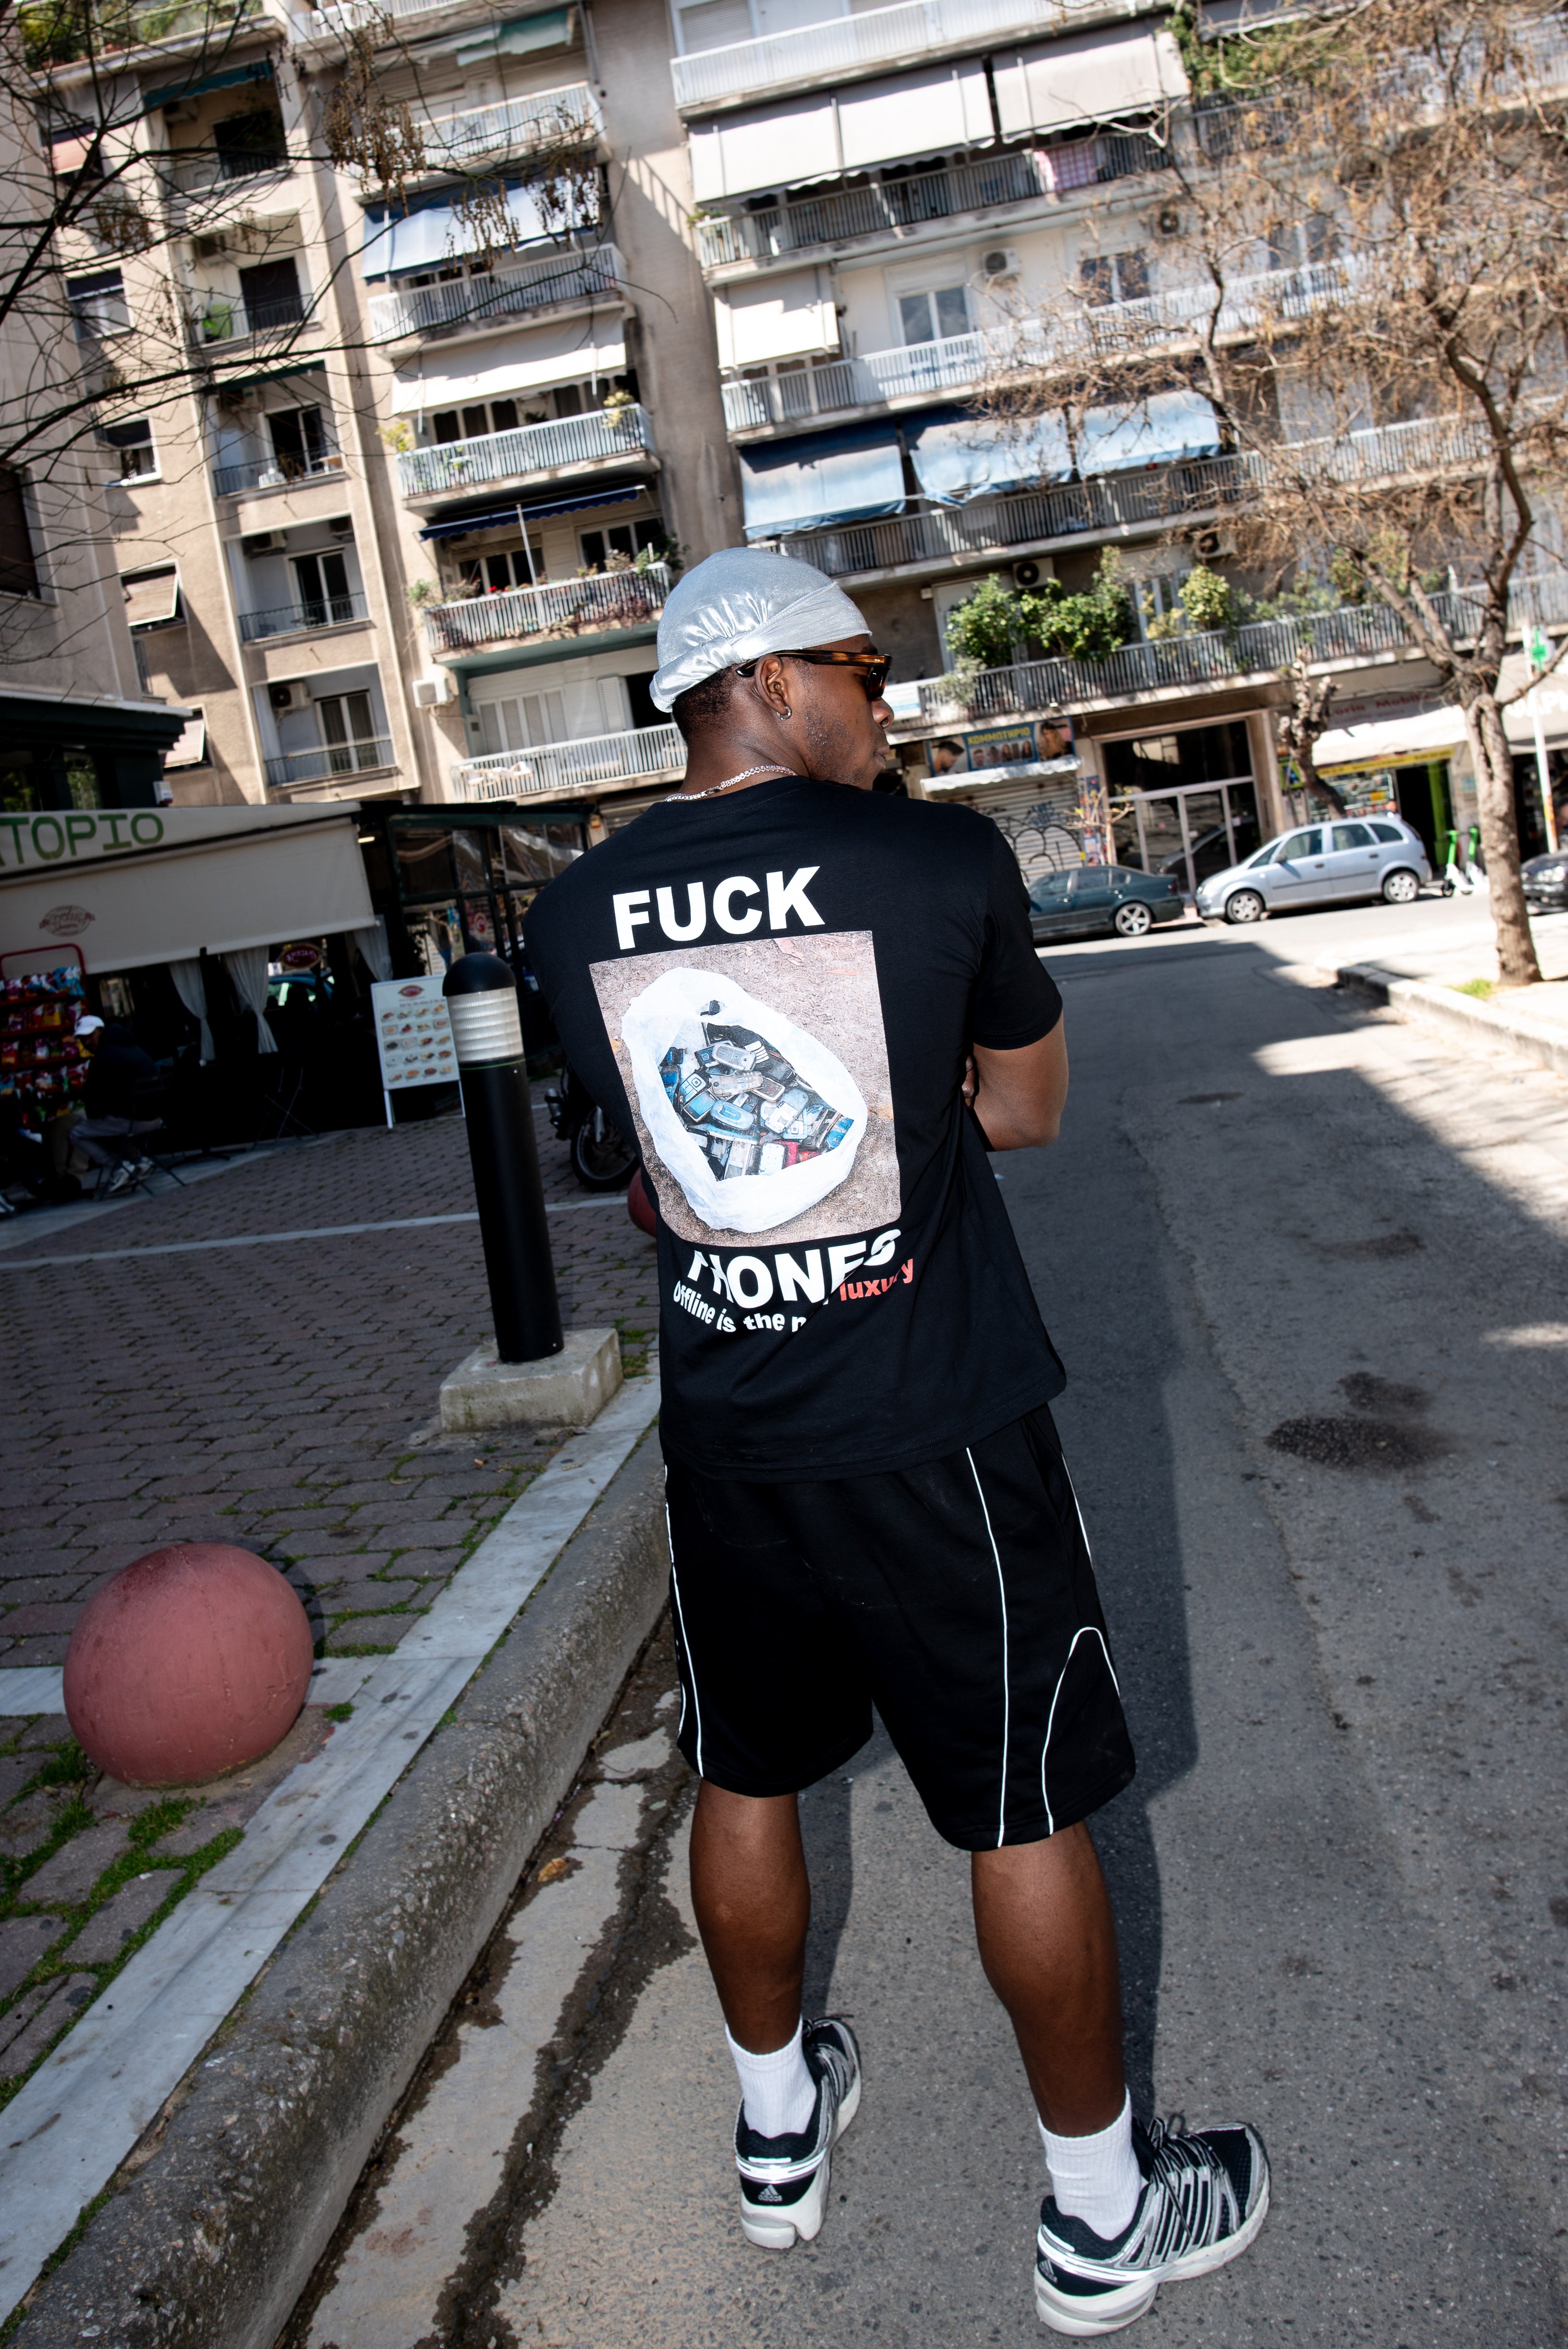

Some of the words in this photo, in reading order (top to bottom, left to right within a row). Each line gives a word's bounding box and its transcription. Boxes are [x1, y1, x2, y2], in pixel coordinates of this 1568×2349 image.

[0, 813, 164, 865] ΤΟΡΙΟ
[612, 866, 825, 950] FUCK
[673, 1280, 716, 1324] Offline
[716, 1308, 736, 1332] is
[743, 1312, 785, 1331] the
